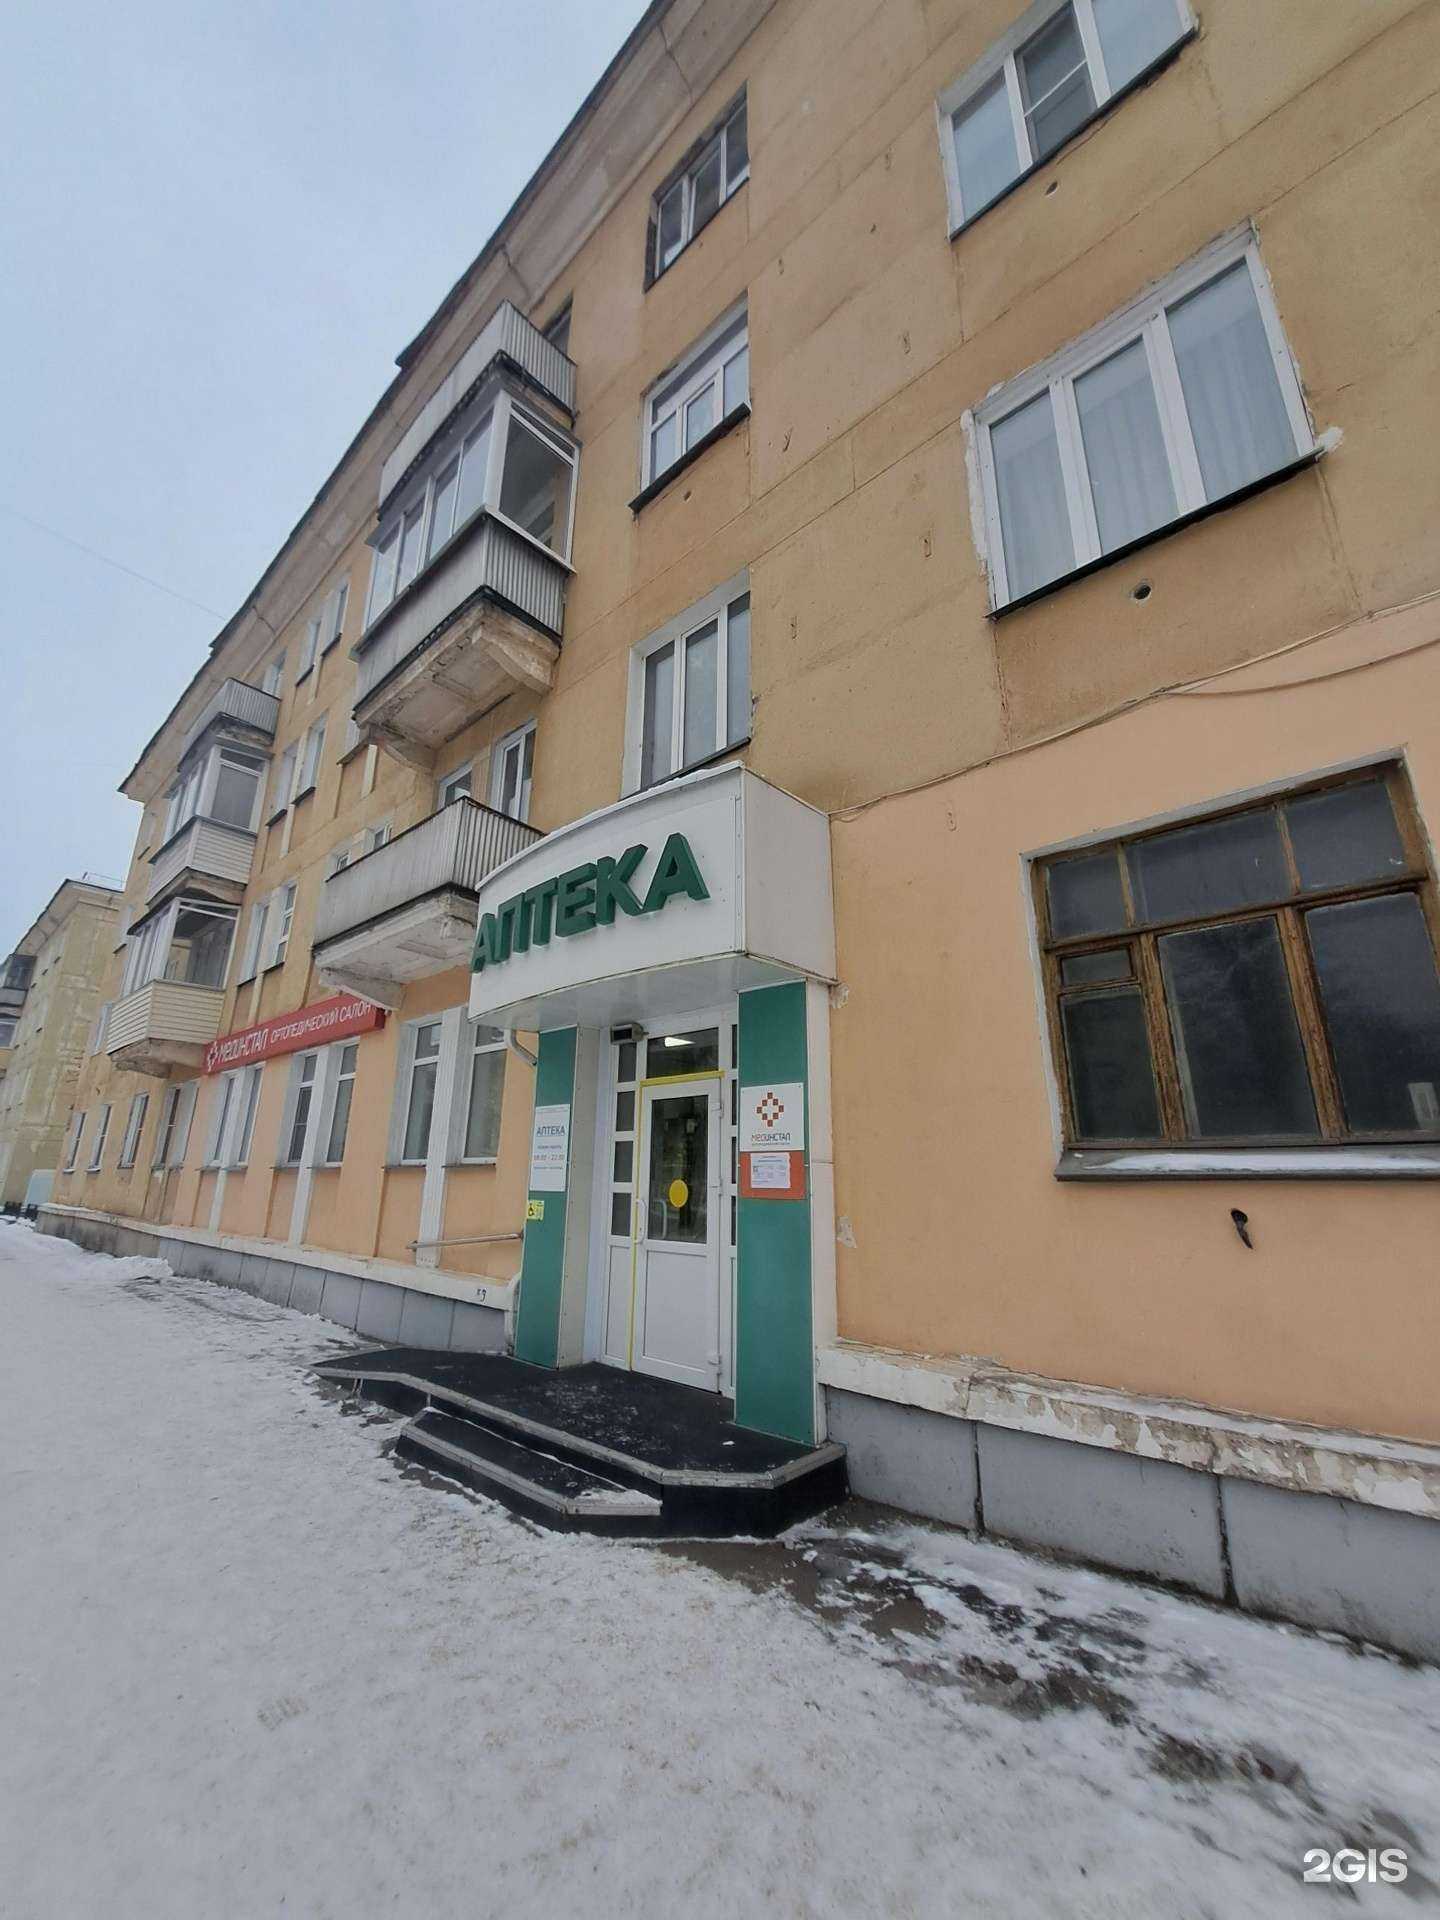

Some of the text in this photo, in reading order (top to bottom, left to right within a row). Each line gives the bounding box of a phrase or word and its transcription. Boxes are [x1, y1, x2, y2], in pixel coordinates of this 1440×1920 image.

[471, 832, 711, 973] АПТЕКА
[339, 1001, 372, 1023] САЛОН
[536, 1125, 565, 1136] АПТЕКА
